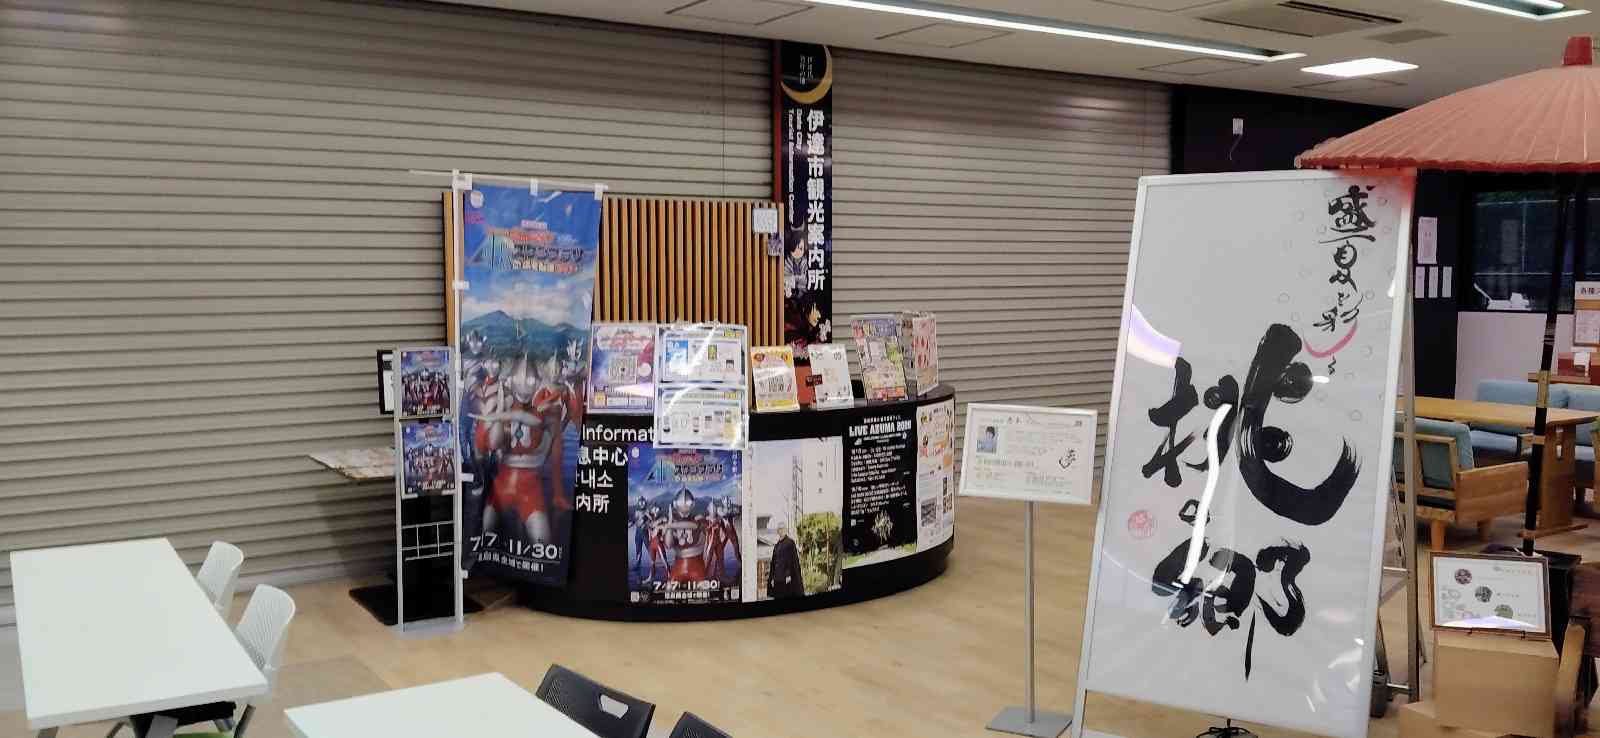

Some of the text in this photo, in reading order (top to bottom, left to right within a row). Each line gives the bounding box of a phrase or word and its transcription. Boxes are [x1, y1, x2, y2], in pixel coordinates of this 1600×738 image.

[795, 131, 803, 152] City
[807, 109, 825, 291] 伊達市観光案内所
[848, 424, 868, 437] LIVE
[869, 421, 896, 435] AZUMA
[576, 468, 613, 489] 내소
